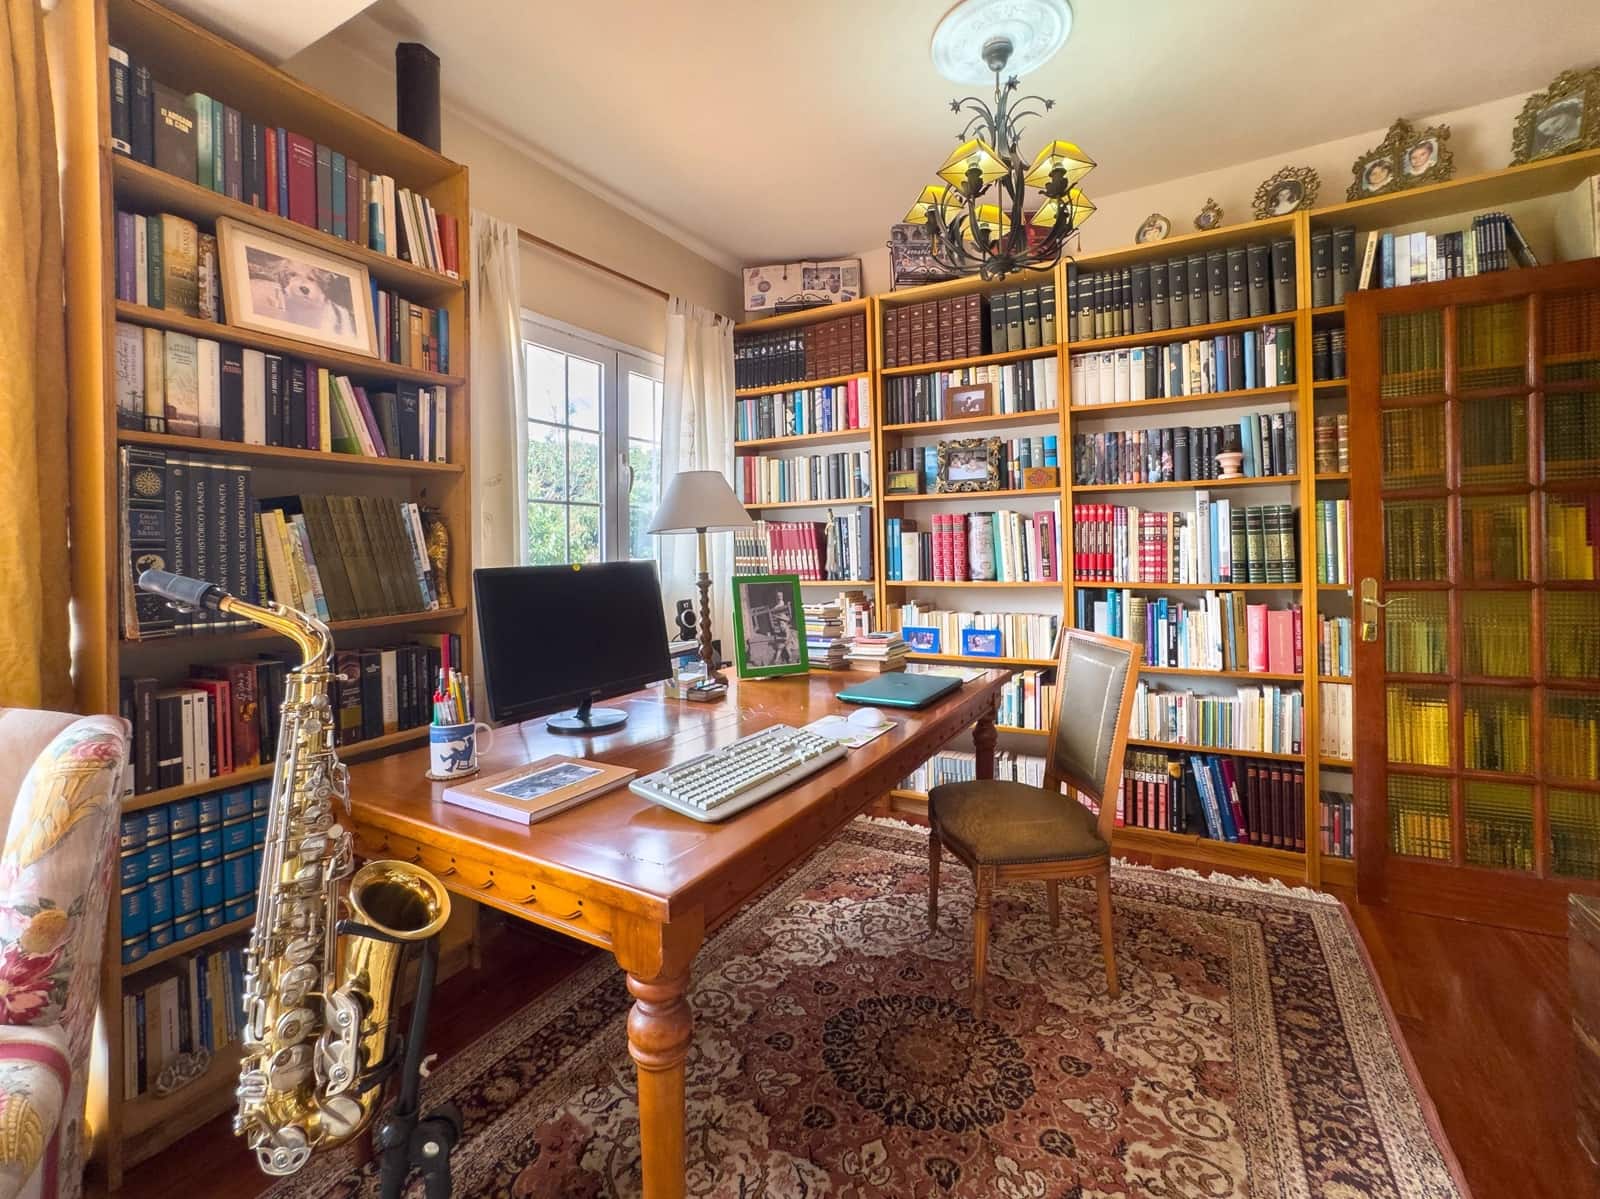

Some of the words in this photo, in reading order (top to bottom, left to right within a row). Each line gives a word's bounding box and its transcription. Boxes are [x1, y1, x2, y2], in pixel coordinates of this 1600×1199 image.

[175, 490, 184, 511] GRAN
[196, 481, 205, 513] PLANETA
[218, 483, 226, 514] PLANETA
[237, 475, 247, 509] HUMANO
[175, 512, 184, 535] ATLAS
[217, 515, 227, 542] ESPAÑA
[238, 509, 247, 538] CUERPO
[219, 543, 227, 554] DE
[239, 540, 247, 553] DEL
[198, 555, 206, 577] ATLAS
[219, 554, 227, 576] ATLAS
[239, 554, 248, 575] ATLAS
[240, 576, 248, 596] GRAN
